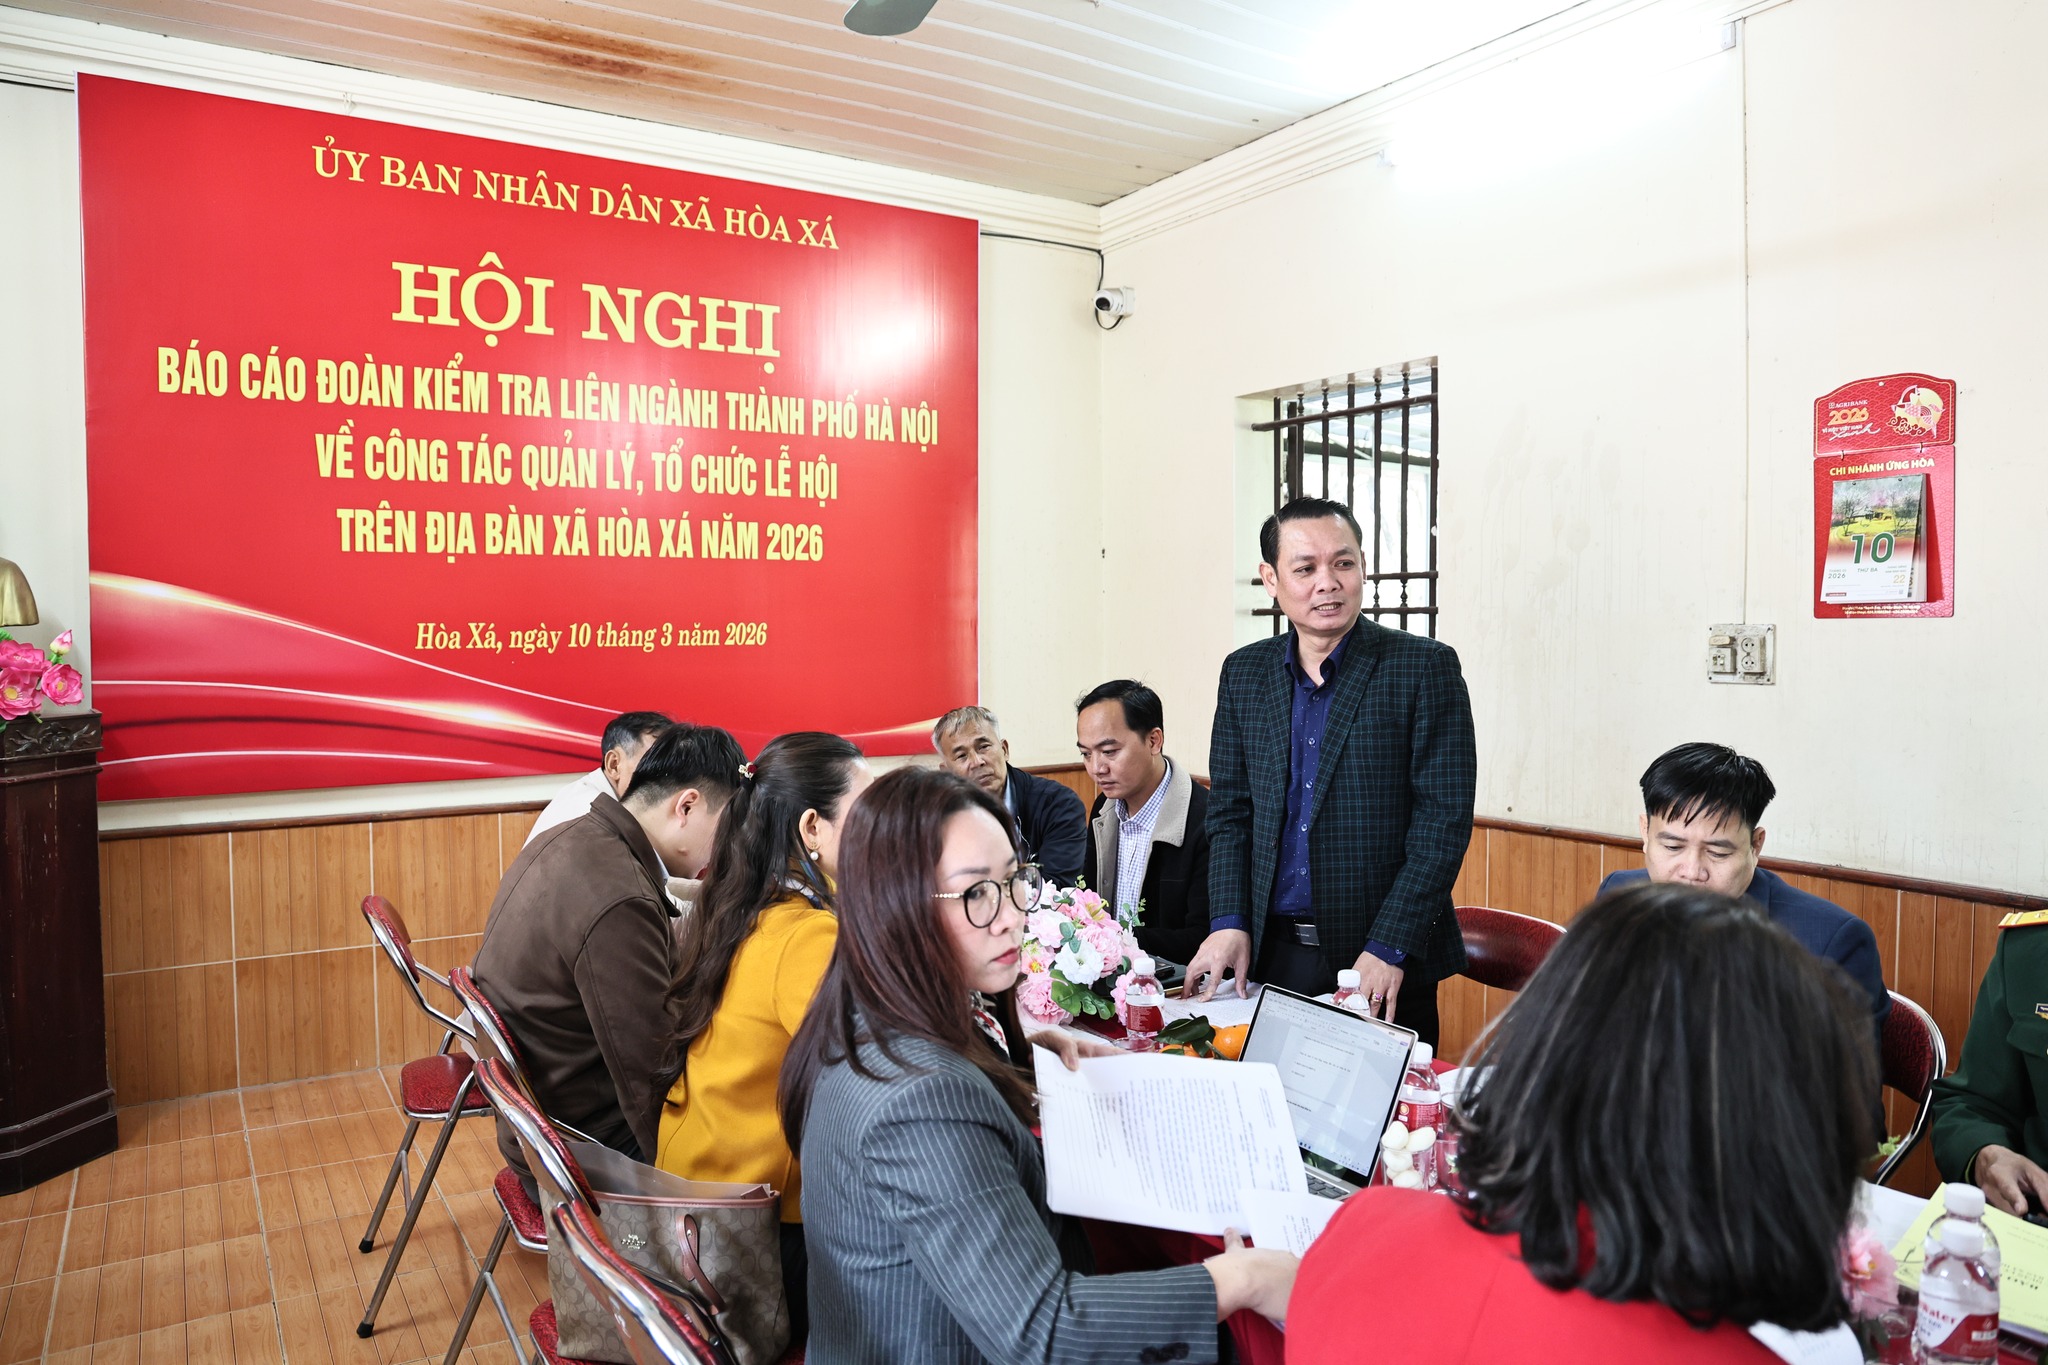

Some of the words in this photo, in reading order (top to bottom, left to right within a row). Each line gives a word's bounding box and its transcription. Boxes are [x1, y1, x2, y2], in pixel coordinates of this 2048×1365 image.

[312, 136, 369, 181] ỦY
[381, 156, 462, 195] BAN
[473, 170, 580, 212] NHÂN
[590, 184, 663, 224] DÂN
[670, 196, 715, 231] XÃ
[724, 204, 792, 243] HÒA
[798, 216, 838, 249] XÁ
[392, 252, 554, 347] HỘI
[582, 283, 780, 374] NGHỊ
[158, 339, 227, 396] BÁO
[240, 346, 306, 402] CÁO
[316, 353, 403, 408] ĐOÀN
[414, 352, 489, 413] KIỂM
[498, 373, 551, 417] TRA
[560, 371, 620, 422] LIÊN
[629, 379, 718, 428] NGÀNH
[725, 386, 804, 435] THÀNH
[812, 389, 859, 440] PHỐ
[865, 398, 896, 442] HÀ
[901, 402, 938, 452] NỘI
[1828, 407, 1870, 425] 2026
[315, 419, 354, 478] VỀ
[365, 428, 448, 482] CÔNG
[457, 433, 512, 485] TÁC
[522, 430, 597, 491] QUẢN
[606, 442, 643, 496] LÝ,
[652, 439, 683, 492] TỔ
[691, 445, 757, 496] CHỨC
[765, 445, 791, 497] LỄ
[799, 454, 837, 507] HỘI
[1829, 467, 1846, 476] CHI
[1848, 463, 1884, 474] NHÁNH
[1885, 460, 1909, 471] ỨNG
[1911, 457, 1935, 468] HÒA
[337, 500, 416, 553] TRÊN
[425, 511, 476, 563] ĐỊA
[485, 505, 543, 555] BÀN
[552, 508, 590, 556] XÃ
[598, 508, 651, 557] HÒA
[659, 511, 694, 558] XÁ
[701, 513, 758, 559] NĂM
[766, 523, 823, 561] 2026
[1851, 532, 1895, 564] 10
[415, 623, 460, 649] Hòa
[466, 623, 502, 653] Xá,
[509, 623, 562, 654] ngày
[568, 623, 591, 647] 10
[597, 622, 657, 652] tháng
[661, 623, 672, 646] 3
[678, 623, 720, 646] năm
[724, 622, 767, 645] 2026
